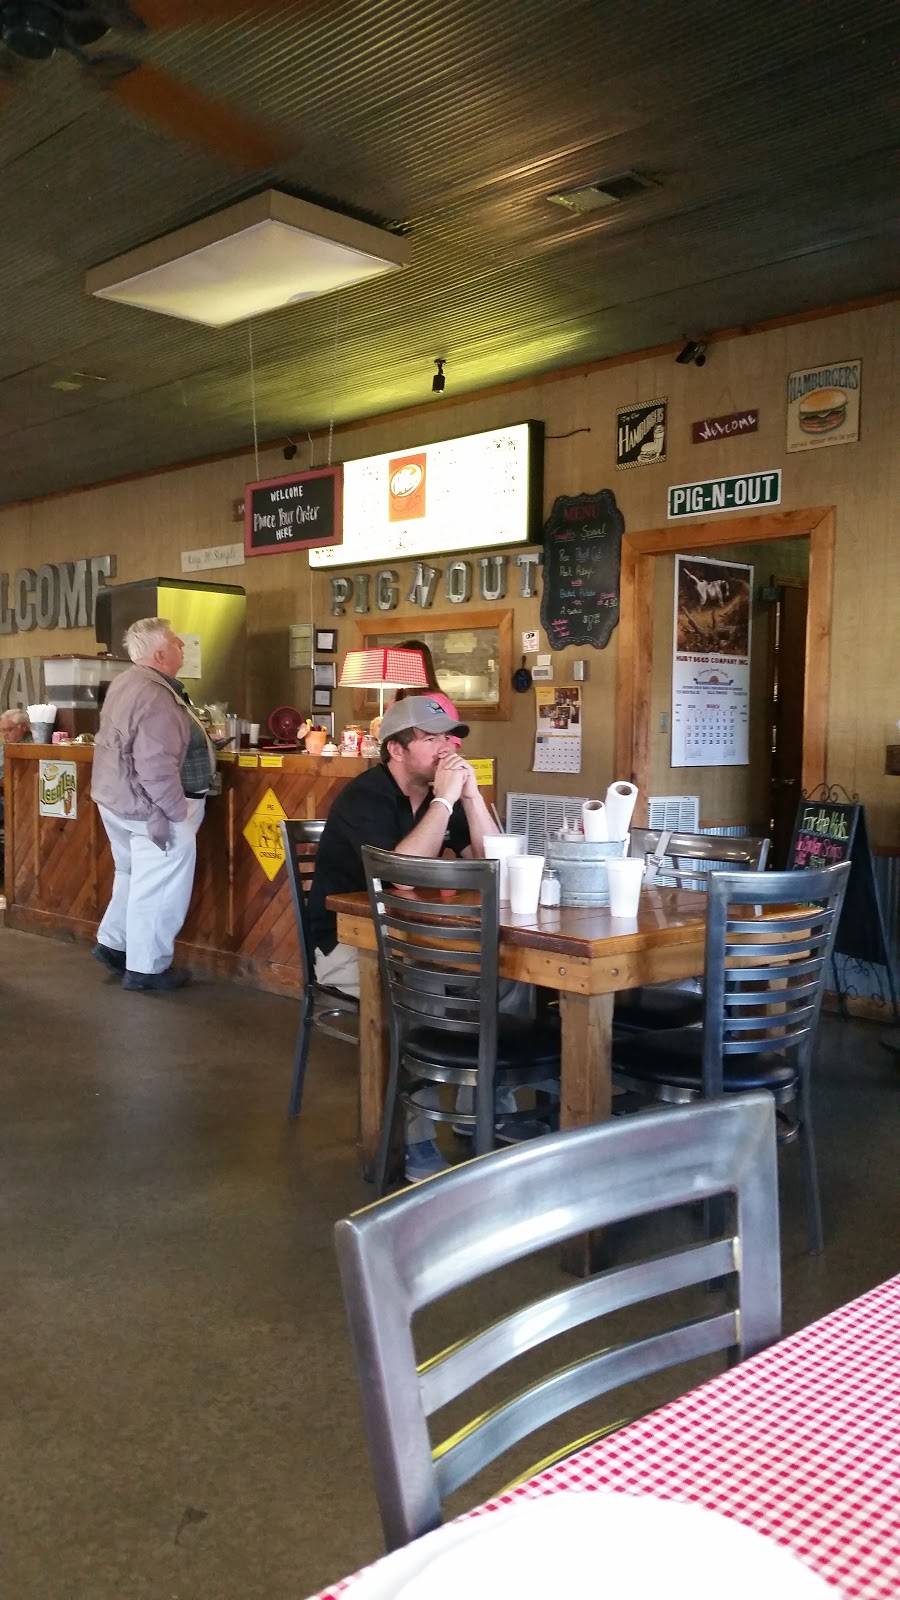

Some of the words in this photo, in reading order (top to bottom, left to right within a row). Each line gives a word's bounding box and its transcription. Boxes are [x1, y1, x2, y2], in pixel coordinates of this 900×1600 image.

[790, 365, 858, 404] HAMBURGERS
[270, 485, 304, 502] WELCOME
[673, 475, 775, 514] PIG-N-OUT
[275, 526, 293, 541] HERE
[711, 657, 737, 665] COMPANY
